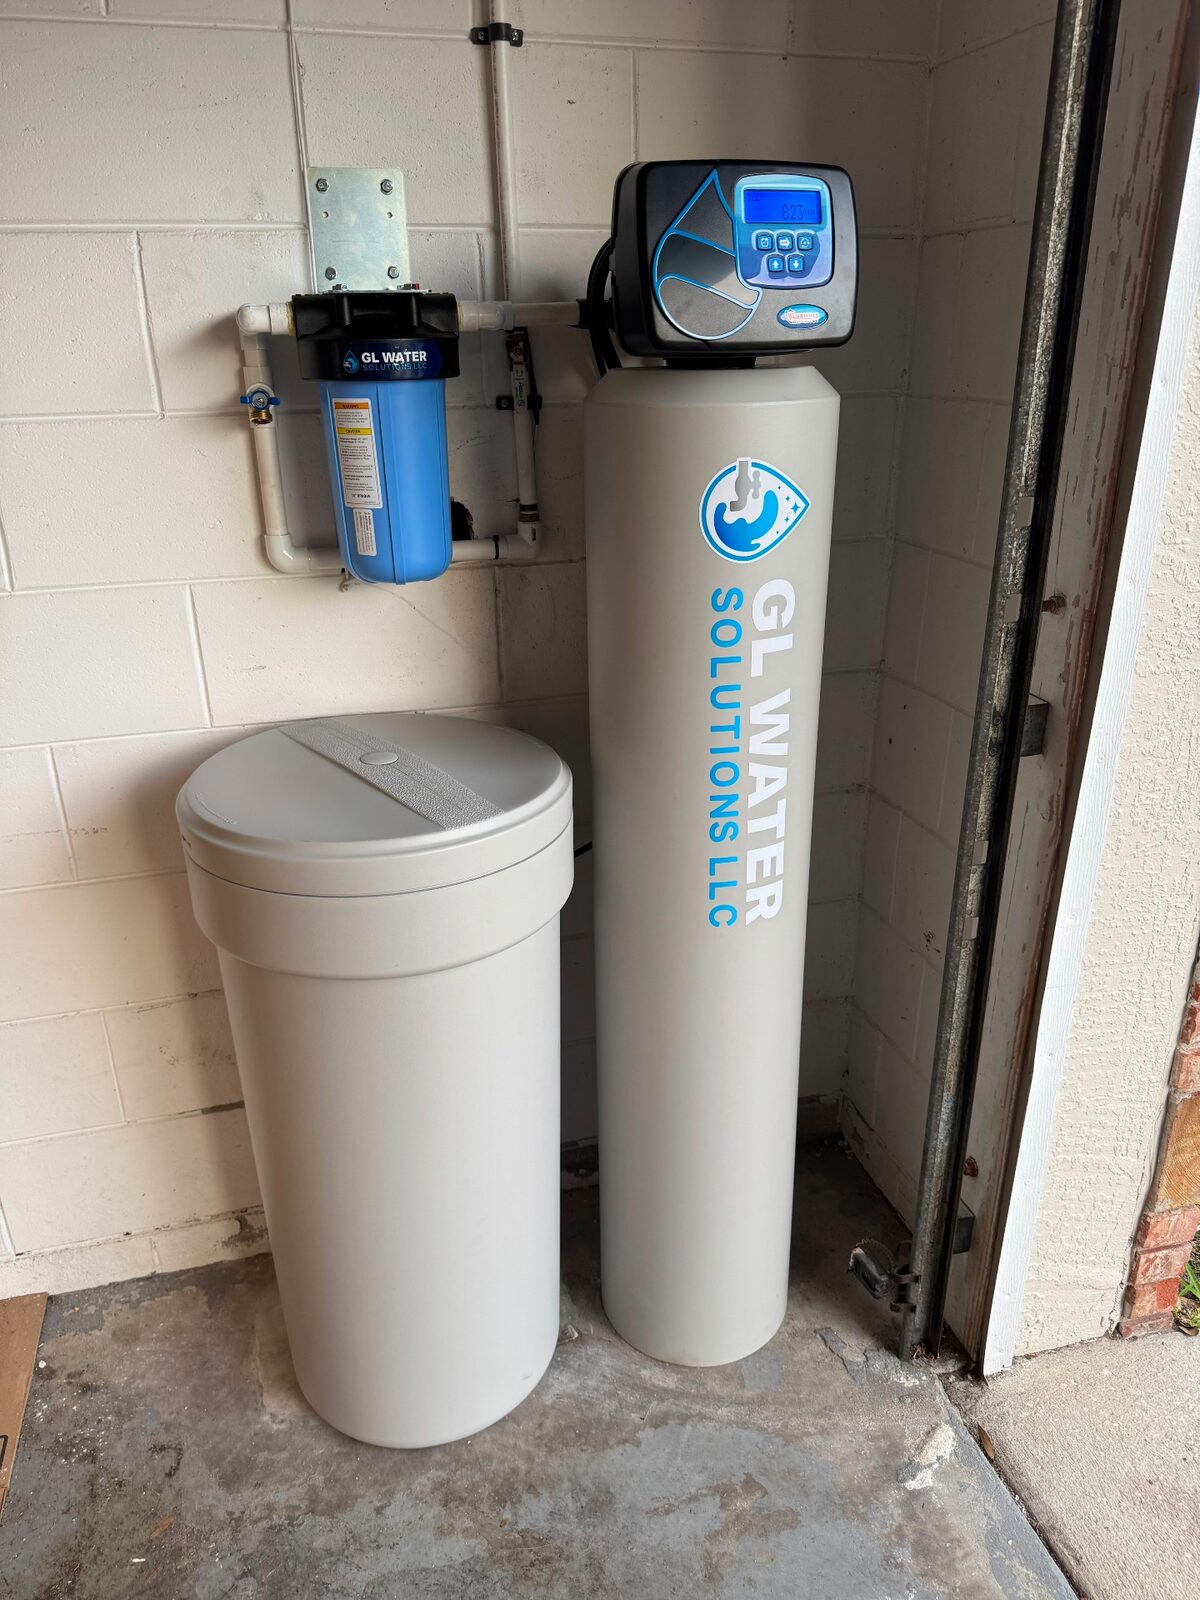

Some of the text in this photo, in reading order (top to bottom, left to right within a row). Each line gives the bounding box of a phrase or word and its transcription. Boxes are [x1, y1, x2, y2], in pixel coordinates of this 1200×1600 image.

[361, 351, 427, 363] GL WATER
[362, 362, 427, 371] SOLUTIONS LLC
[708, 587, 744, 928] SOLUTIONS LLC
[744, 578, 796, 926] GL WATER
